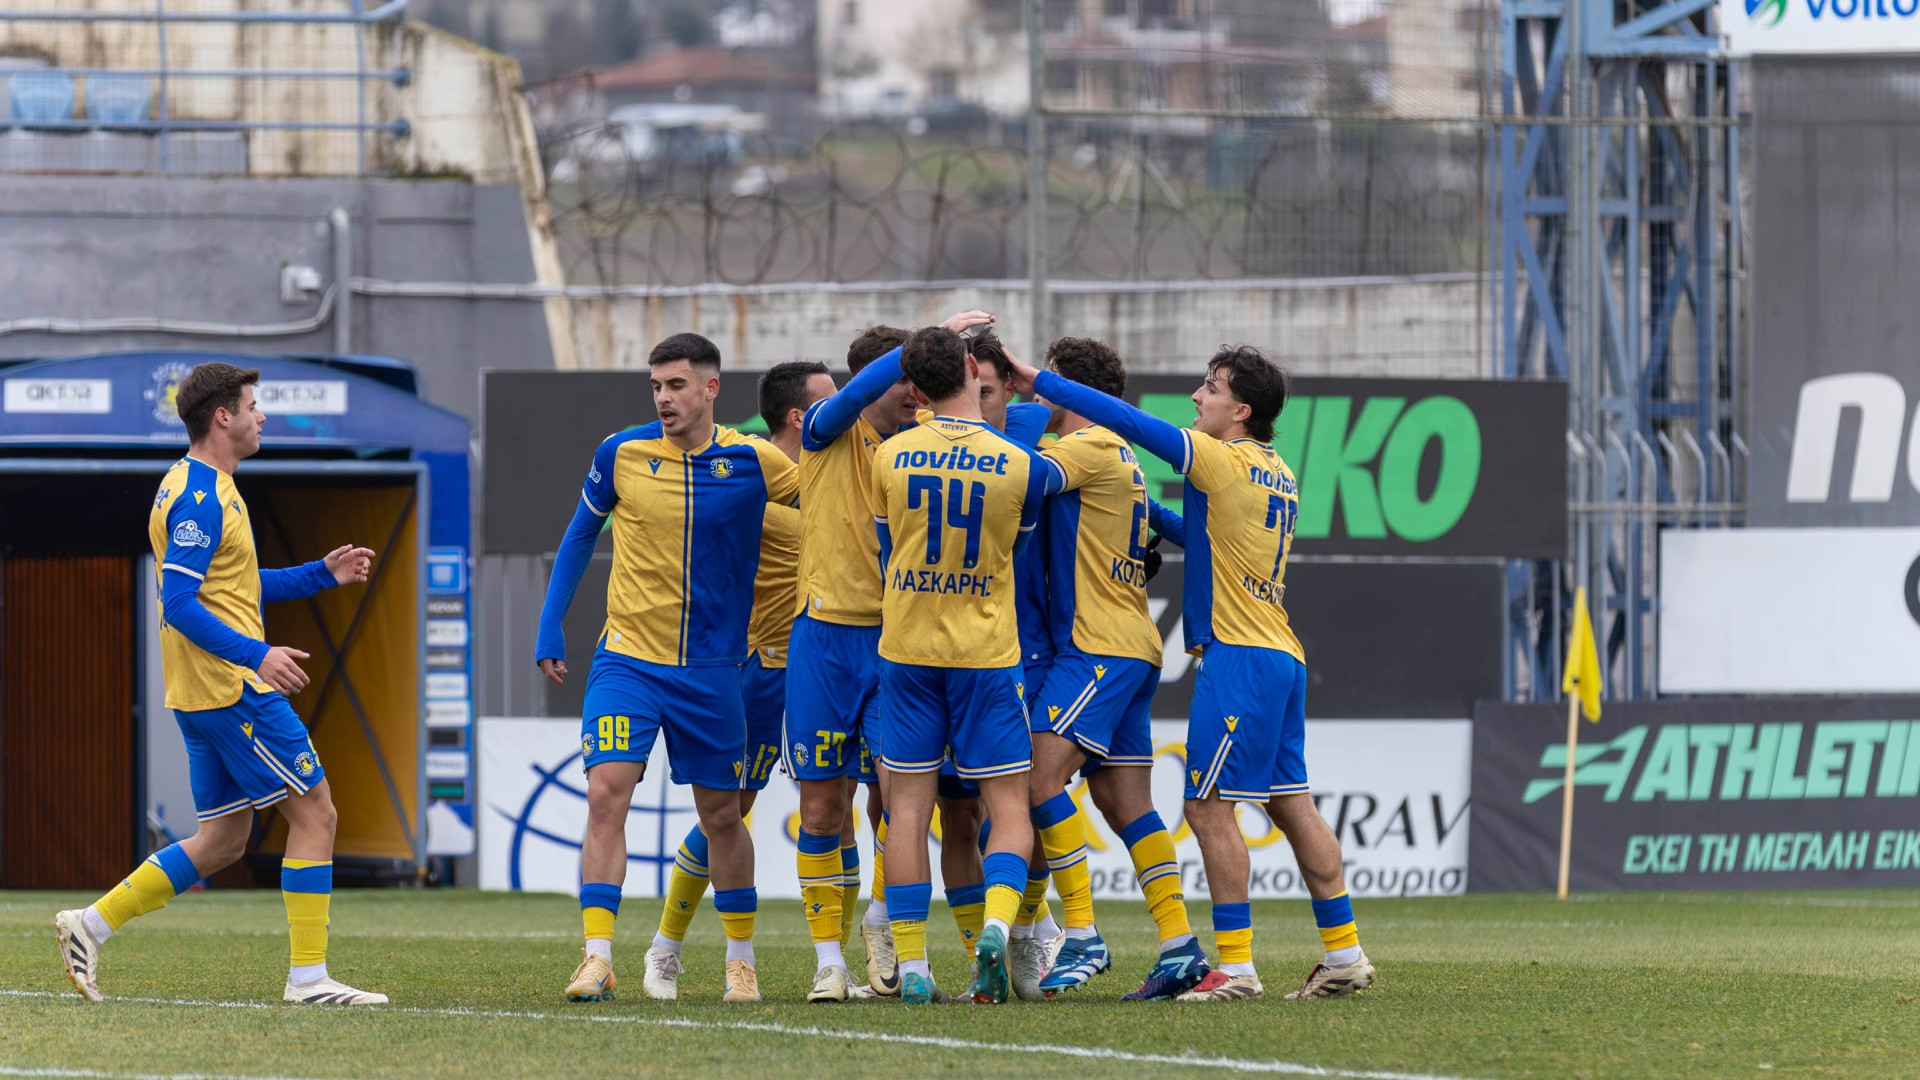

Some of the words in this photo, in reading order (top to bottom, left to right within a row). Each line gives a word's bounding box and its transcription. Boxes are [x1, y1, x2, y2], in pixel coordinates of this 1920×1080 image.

[940, 423, 968, 432] ASTERAS
[1786, 371, 1920, 504] n
[894, 446, 1009, 476] novibet
[908, 474, 986, 569] 74
[598, 715, 630, 751] 99
[815, 730, 847, 767] 27
